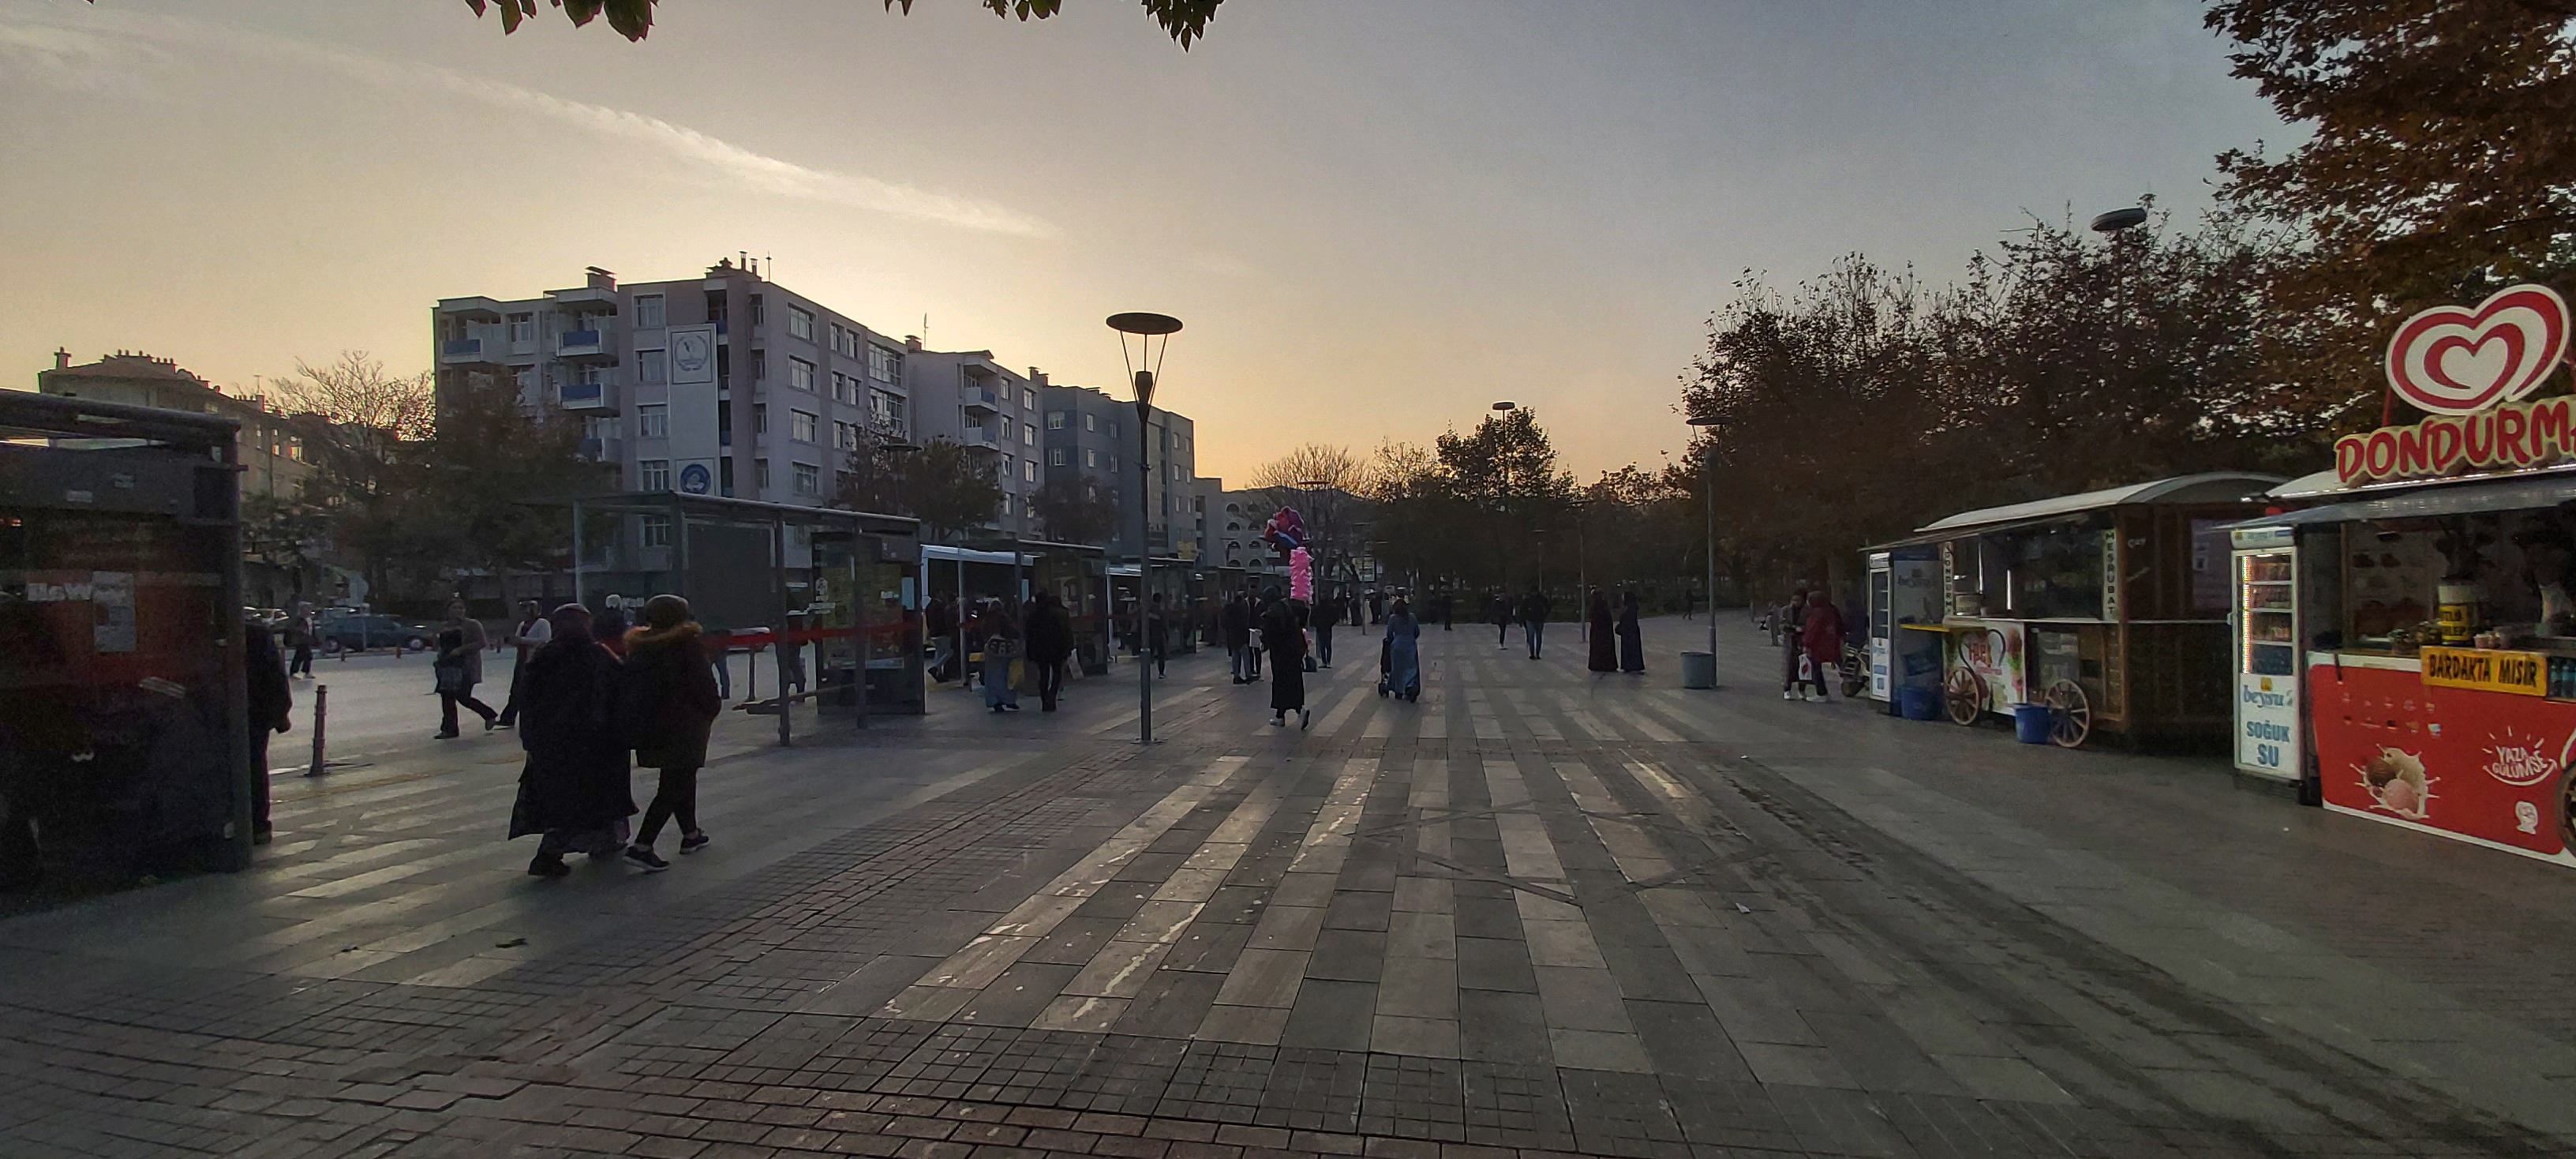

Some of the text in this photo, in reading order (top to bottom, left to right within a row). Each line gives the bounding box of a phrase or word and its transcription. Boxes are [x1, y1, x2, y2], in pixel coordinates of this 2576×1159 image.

[2336, 400, 2576, 483] DONDURM
[2428, 655, 2537, 688] BARDAKTA MISIR
[2246, 719, 2290, 743] SOĞUK
[2256, 744, 2279, 767] SU
[2496, 745, 2529, 765] YAZA
